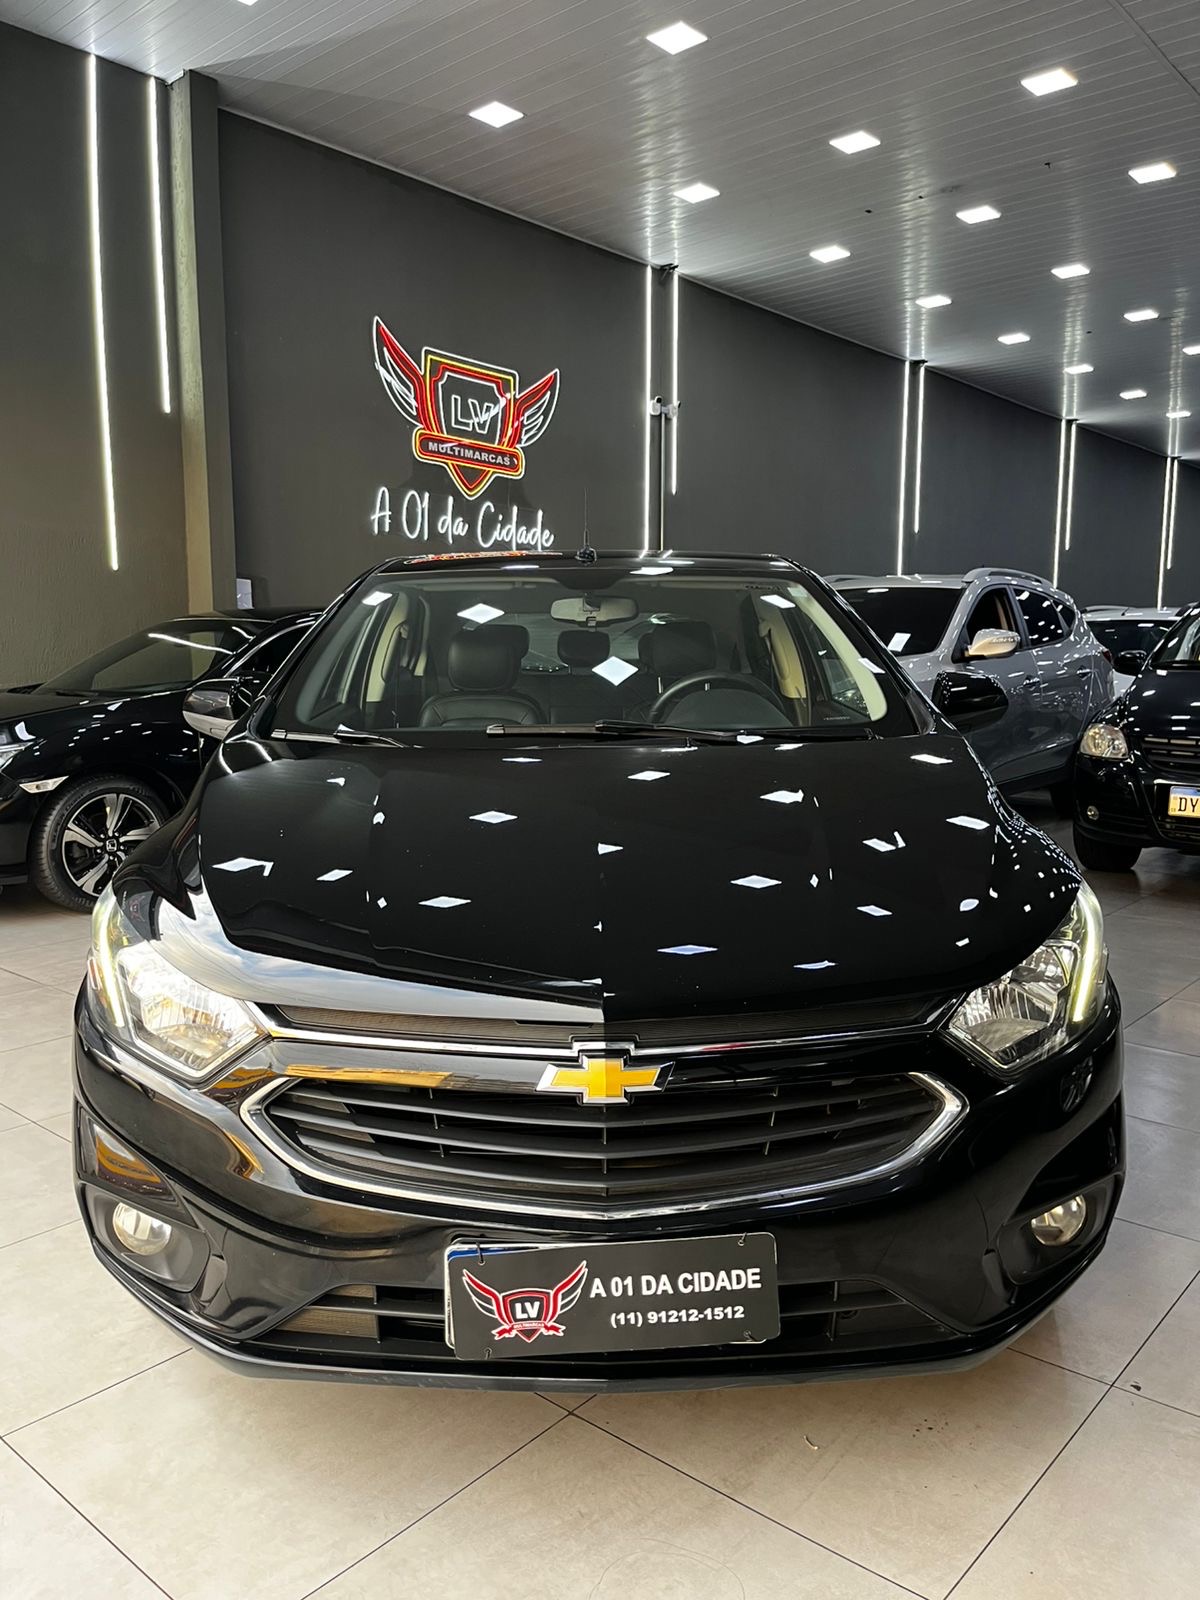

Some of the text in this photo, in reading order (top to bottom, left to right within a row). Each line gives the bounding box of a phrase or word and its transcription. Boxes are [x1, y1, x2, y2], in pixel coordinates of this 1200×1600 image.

[451, 394, 494, 435] LV
[428, 441, 511, 466] MULTIMARCAS
[371, 487, 392, 535] A
[438, 496, 469, 544] da
[477, 502, 554, 551] Cidade
[589, 1267, 762, 1298] A 01 DA CIDADE
[514, 1301, 541, 1320] LV
[610, 1305, 745, 1329] (11) 91212-1512
